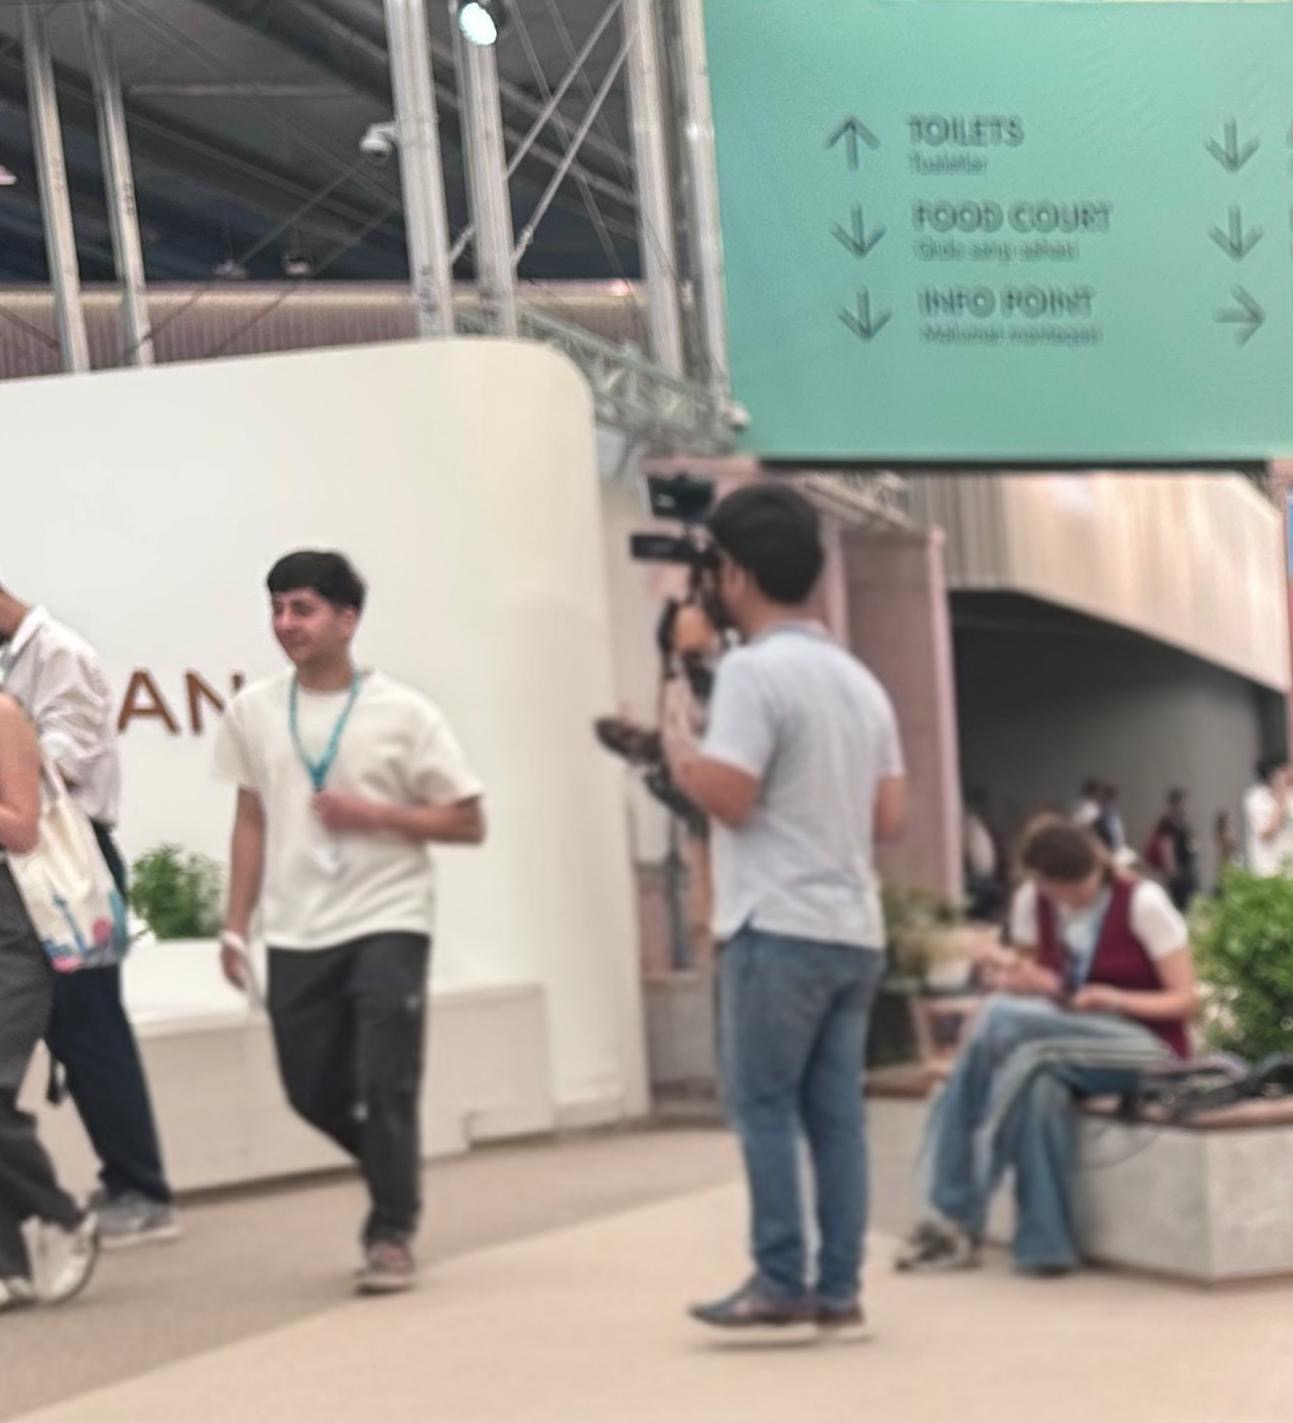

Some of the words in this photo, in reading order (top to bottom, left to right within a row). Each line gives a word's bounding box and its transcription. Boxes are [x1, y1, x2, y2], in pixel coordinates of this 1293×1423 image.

[908, 114, 1024, 147] TOILETS
[913, 201, 1003, 233] FOOD
[1009, 202, 1112, 234] COURT
[918, 286, 996, 318] INFO
[1002, 286, 1096, 318] POINT
